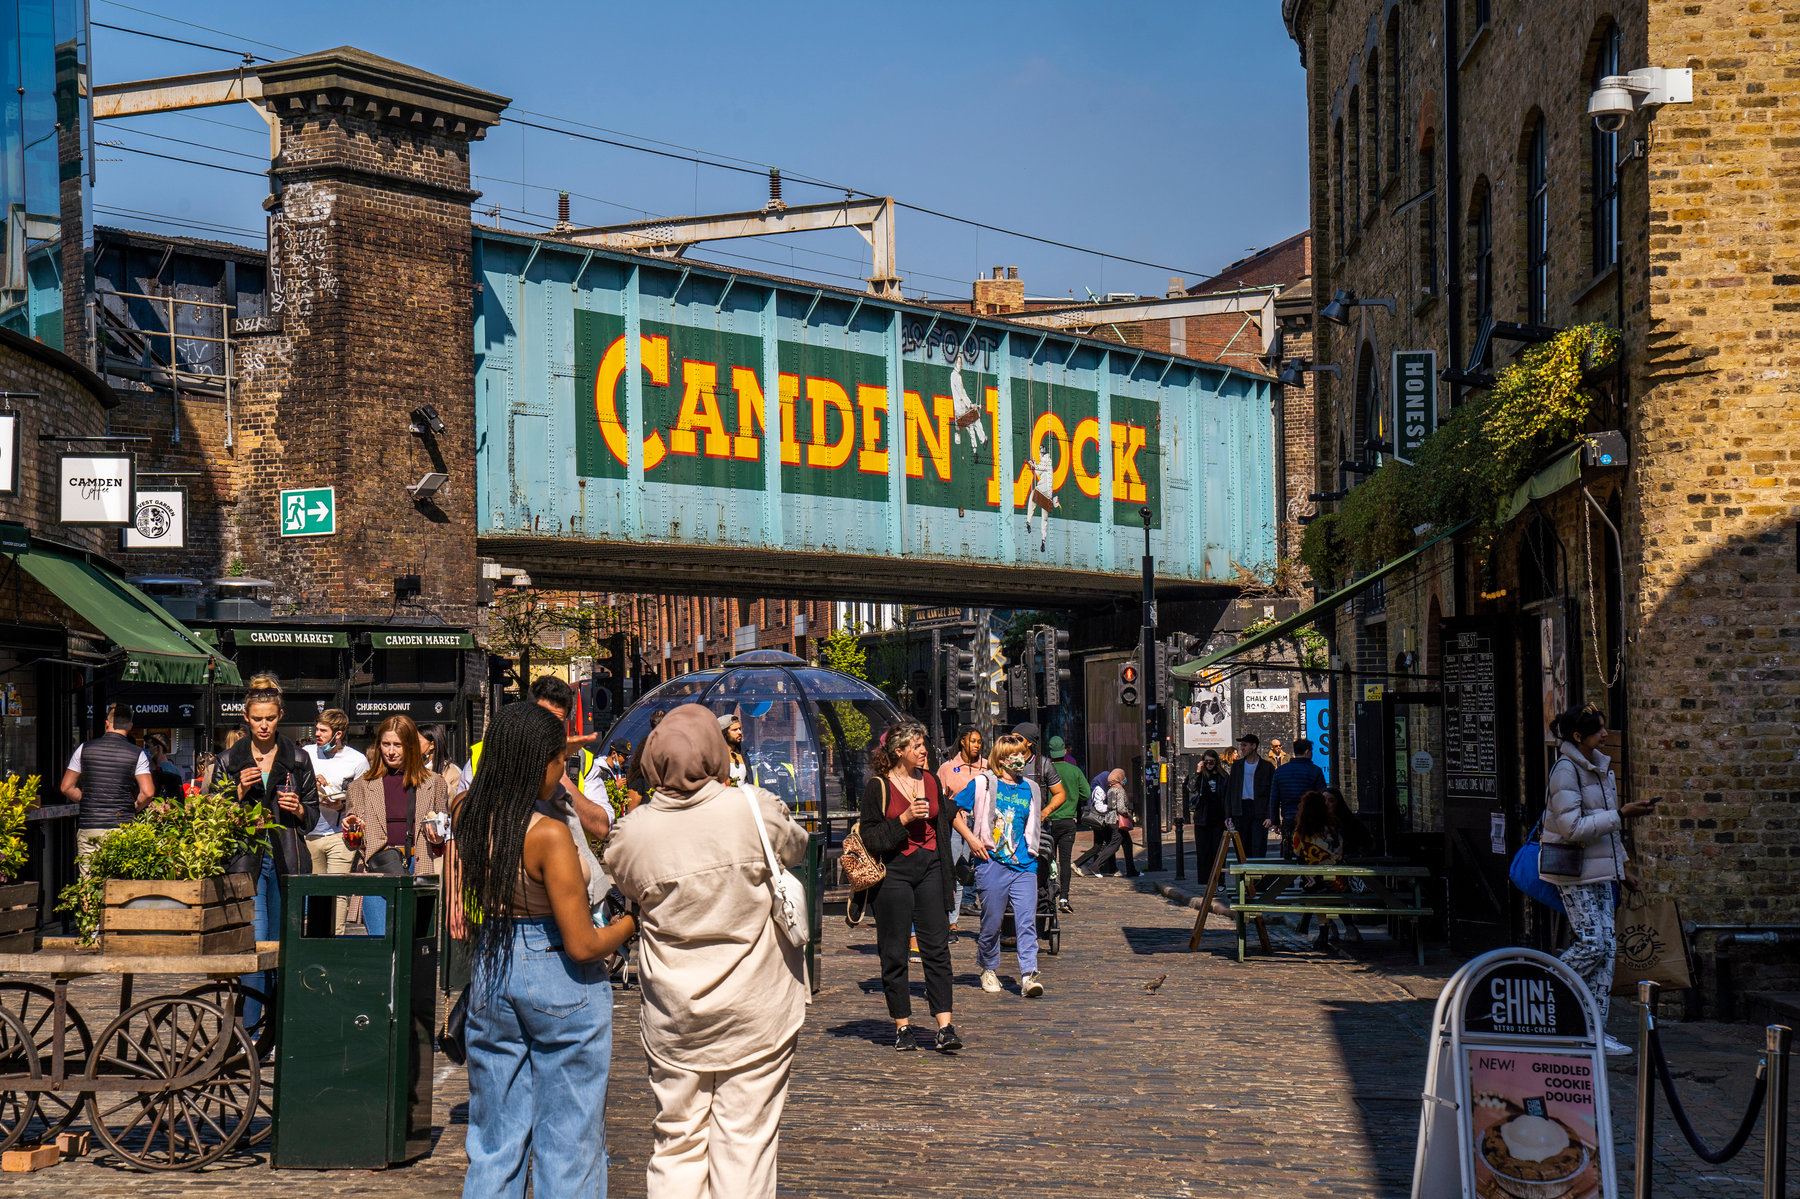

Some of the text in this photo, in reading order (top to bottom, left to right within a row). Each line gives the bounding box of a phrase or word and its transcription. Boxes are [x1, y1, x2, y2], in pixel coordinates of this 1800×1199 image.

[1405, 362, 1426, 448] HONEST
[595, 333, 1147, 509] CAMDEN LOCK
[69, 477, 123, 487] CAMDEN
[81, 480, 110, 500] Coffee
[154, 500, 176, 517] GARDEN
[251, 632, 334, 644] CAMDEN MARKET
[385, 635, 461, 645] CAMDEN MARKET
[135, 704, 169, 713] CAMDEN
[220, 703, 245, 712] CAMDE
[356, 703, 411, 711] CHURROS DONUT
[1617, 923, 1660, 943] ROKIT
[1623, 954, 1659, 969] LONDON
[1490, 978, 1545, 1002] CHIN
[1491, 1001, 1546, 1026] CHIN
[1493, 1024, 1557, 1034] NITRO ICE-CREAM
[1479, 1056, 1515, 1072] NEW!
[1532, 1062, 1591, 1077] GRIDDLED
[1544, 1077, 1592, 1091] COOKIE
[1545, 1090, 1592, 1105] DOUGH
